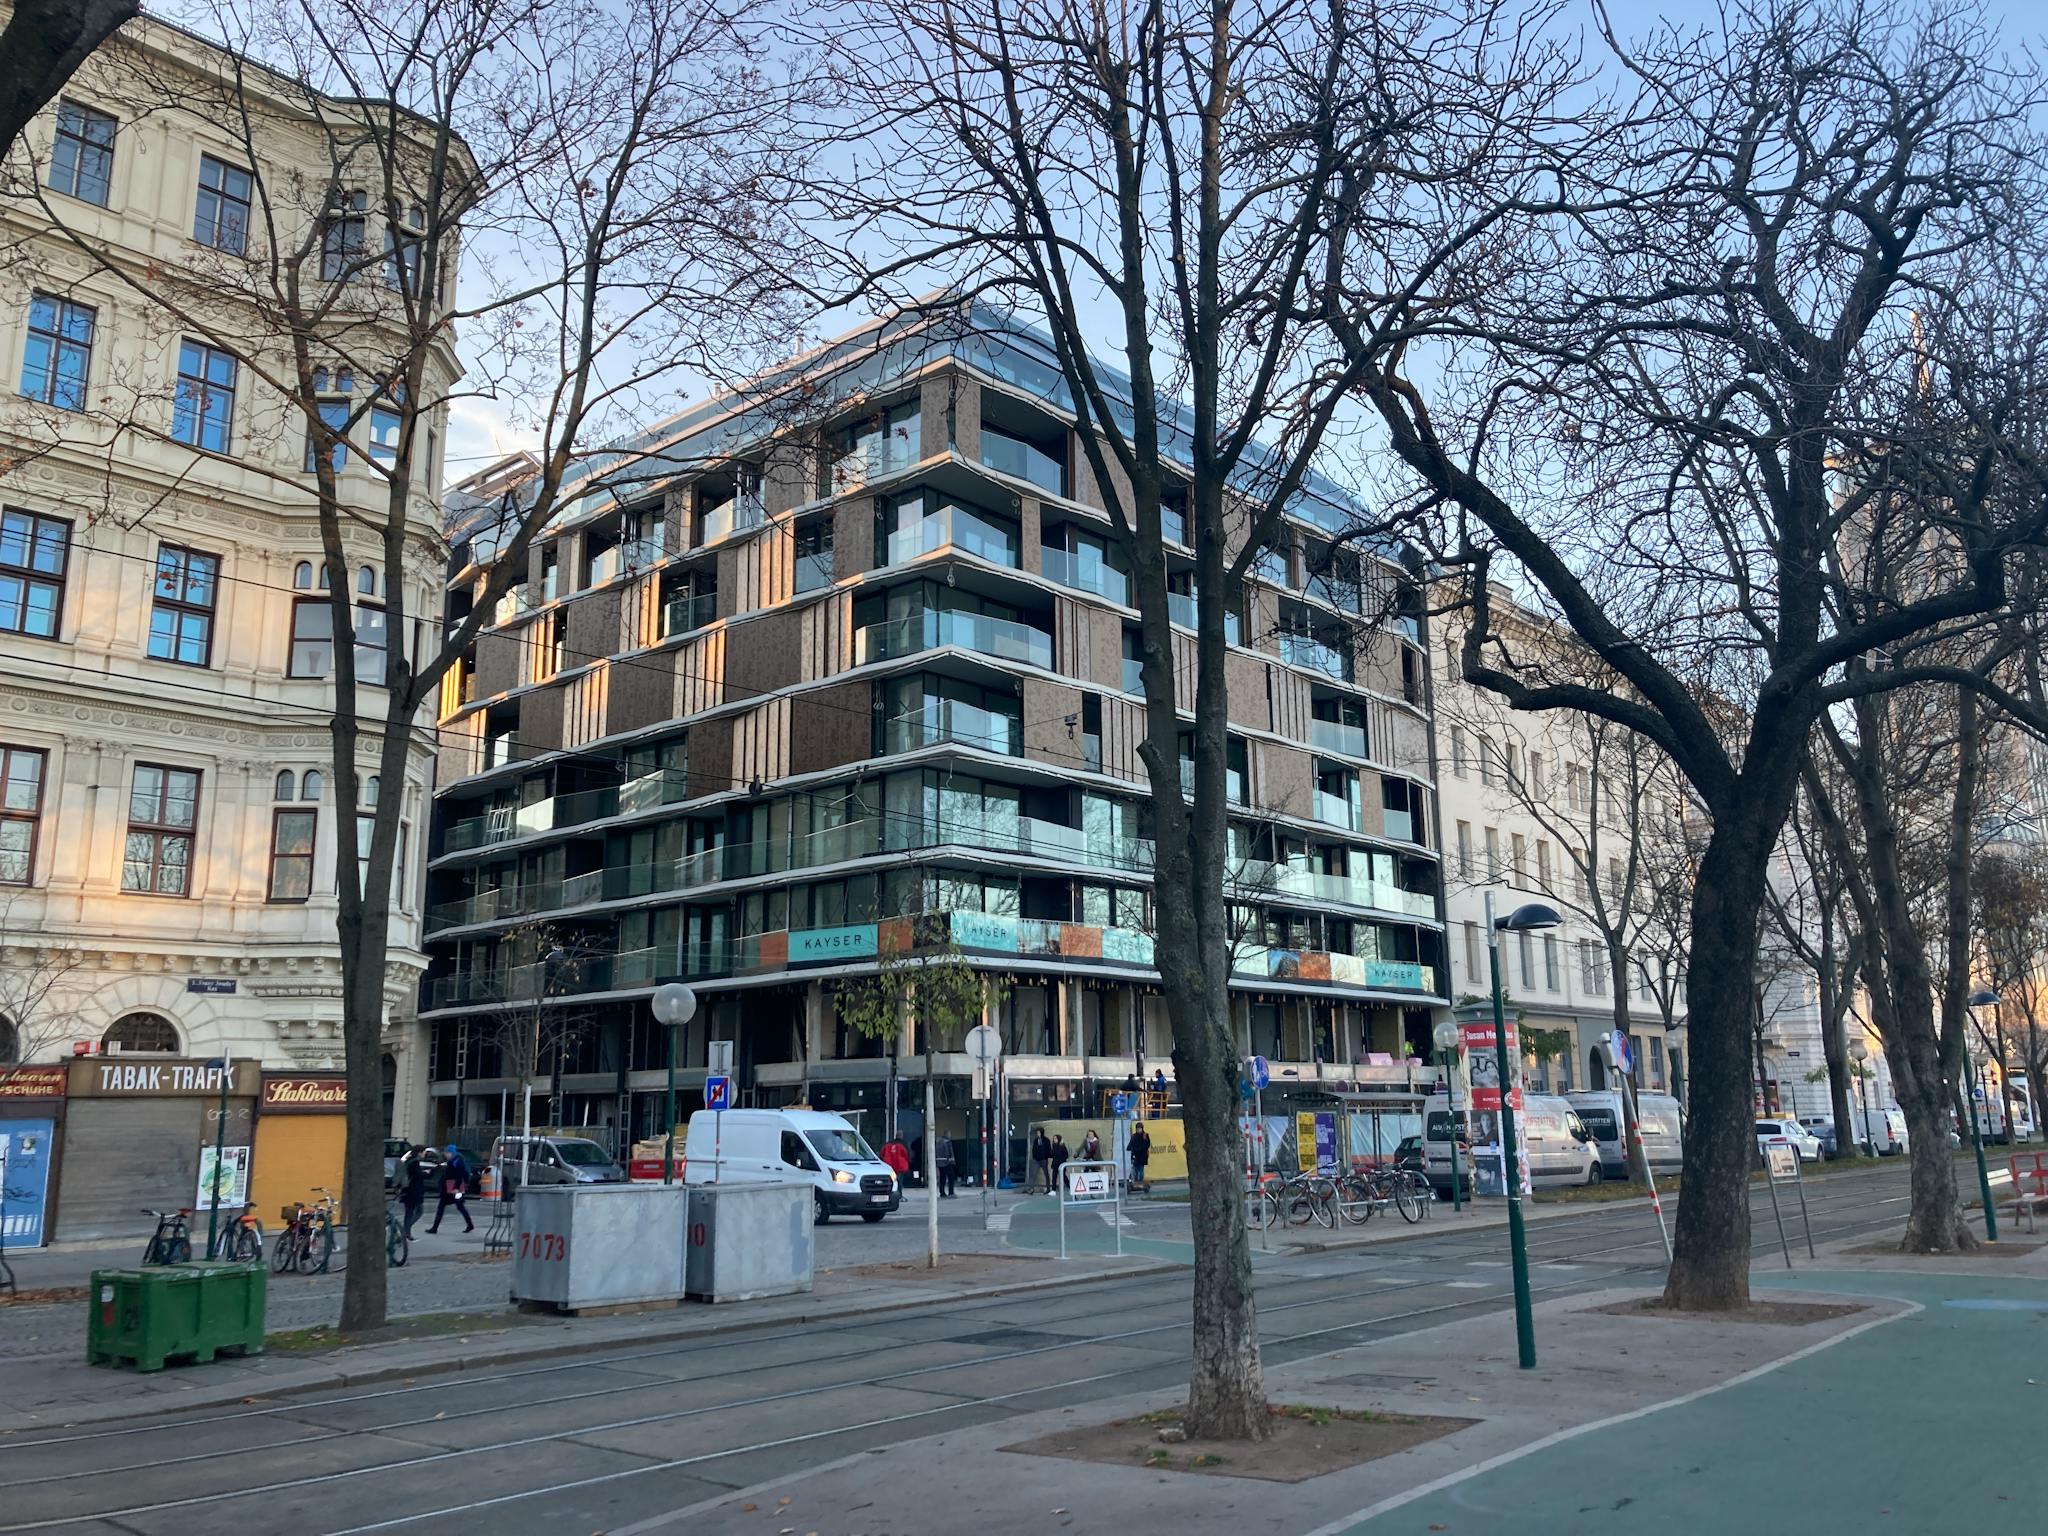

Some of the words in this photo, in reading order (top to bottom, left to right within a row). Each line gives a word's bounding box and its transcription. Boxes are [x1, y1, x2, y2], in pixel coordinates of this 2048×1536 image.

[805, 934, 862, 950] KAYSER
[1374, 969, 1413, 979] KAYSER
[101, 1066, 236, 1090] TABAK-TRAFIK
[520, 1232, 565, 1262] 7073
